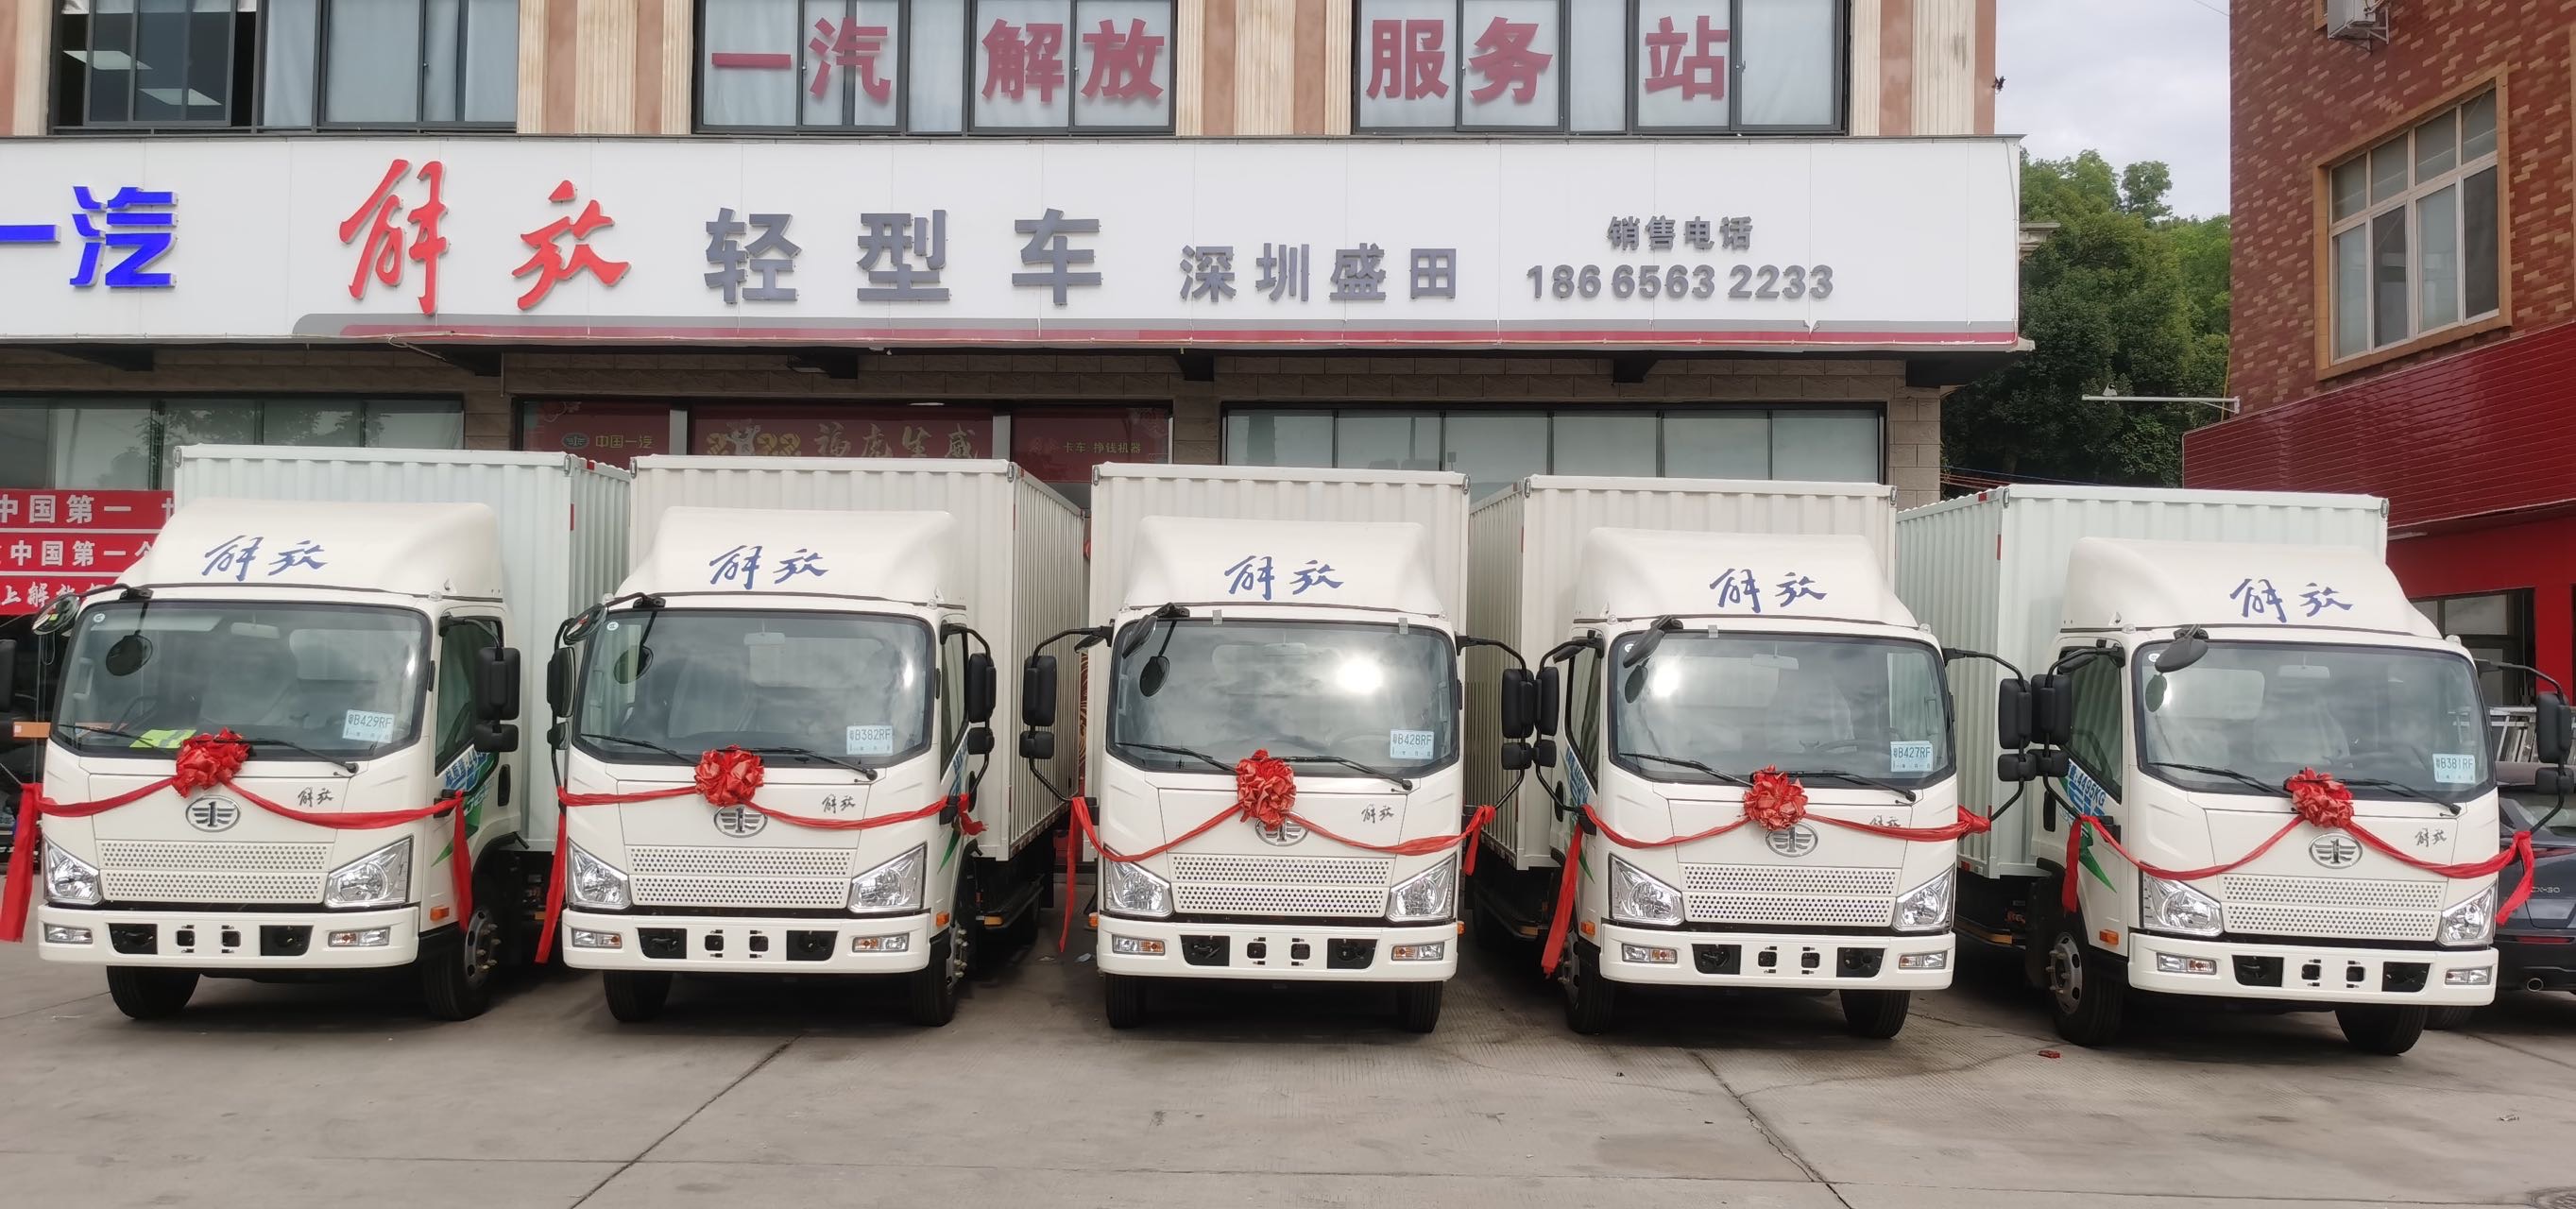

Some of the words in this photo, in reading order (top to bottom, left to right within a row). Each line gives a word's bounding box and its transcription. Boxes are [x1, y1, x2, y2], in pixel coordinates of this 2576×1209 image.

[0, 185, 178, 288] 一汽
[339, 159, 630, 315] 解放
[1607, 215, 1754, 252] 销售电话
[705, 207, 1103, 306] 轻型车
[1180, 242, 1458, 303] 深圳盛田
[1527, 264, 1602, 299] 186
[1612, 264, 1715, 299] 6563
[1729, 264, 1834, 299] 2233
[595, 434, 653, 450] 中国一汽
[201, 535, 329, 582] 解放
[709, 545, 829, 590] 解放
[1224, 555, 1344, 600] 解放
[1710, 569, 1828, 613] 解放
[2230, 578, 2353, 623] 解放
[298, 786, 333, 808] 解放
[822, 793, 856, 813] 解放
[1361, 803, 1395, 824] 解放
[2414, 827, 2448, 847] 解放
